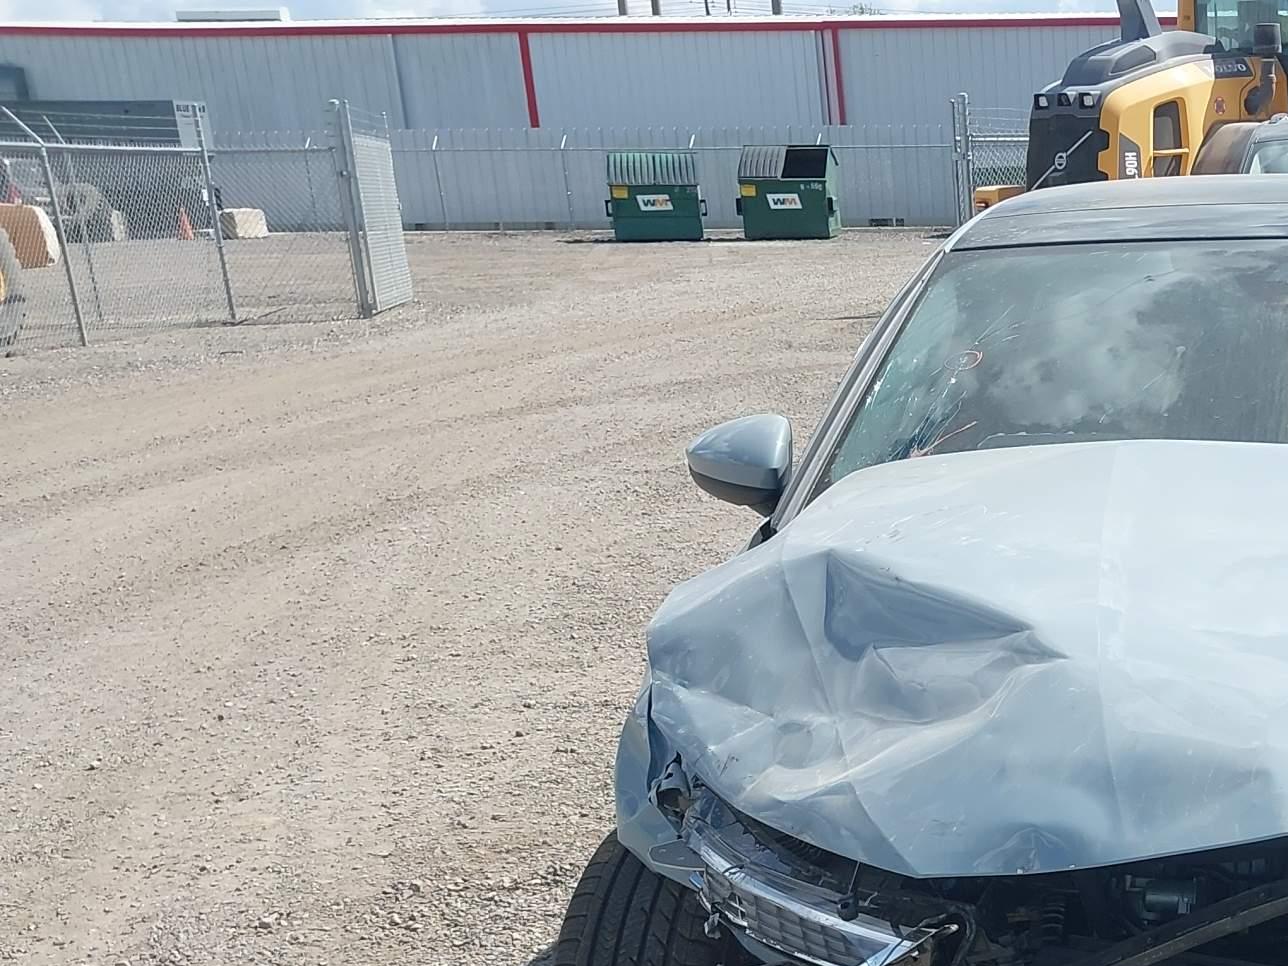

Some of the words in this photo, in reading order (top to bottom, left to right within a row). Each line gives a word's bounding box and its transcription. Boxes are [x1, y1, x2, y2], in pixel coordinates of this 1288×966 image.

[1125, 152, 1138, 178] 90H
[643, 198, 669, 207] WM
[772, 198, 798, 206] WM
